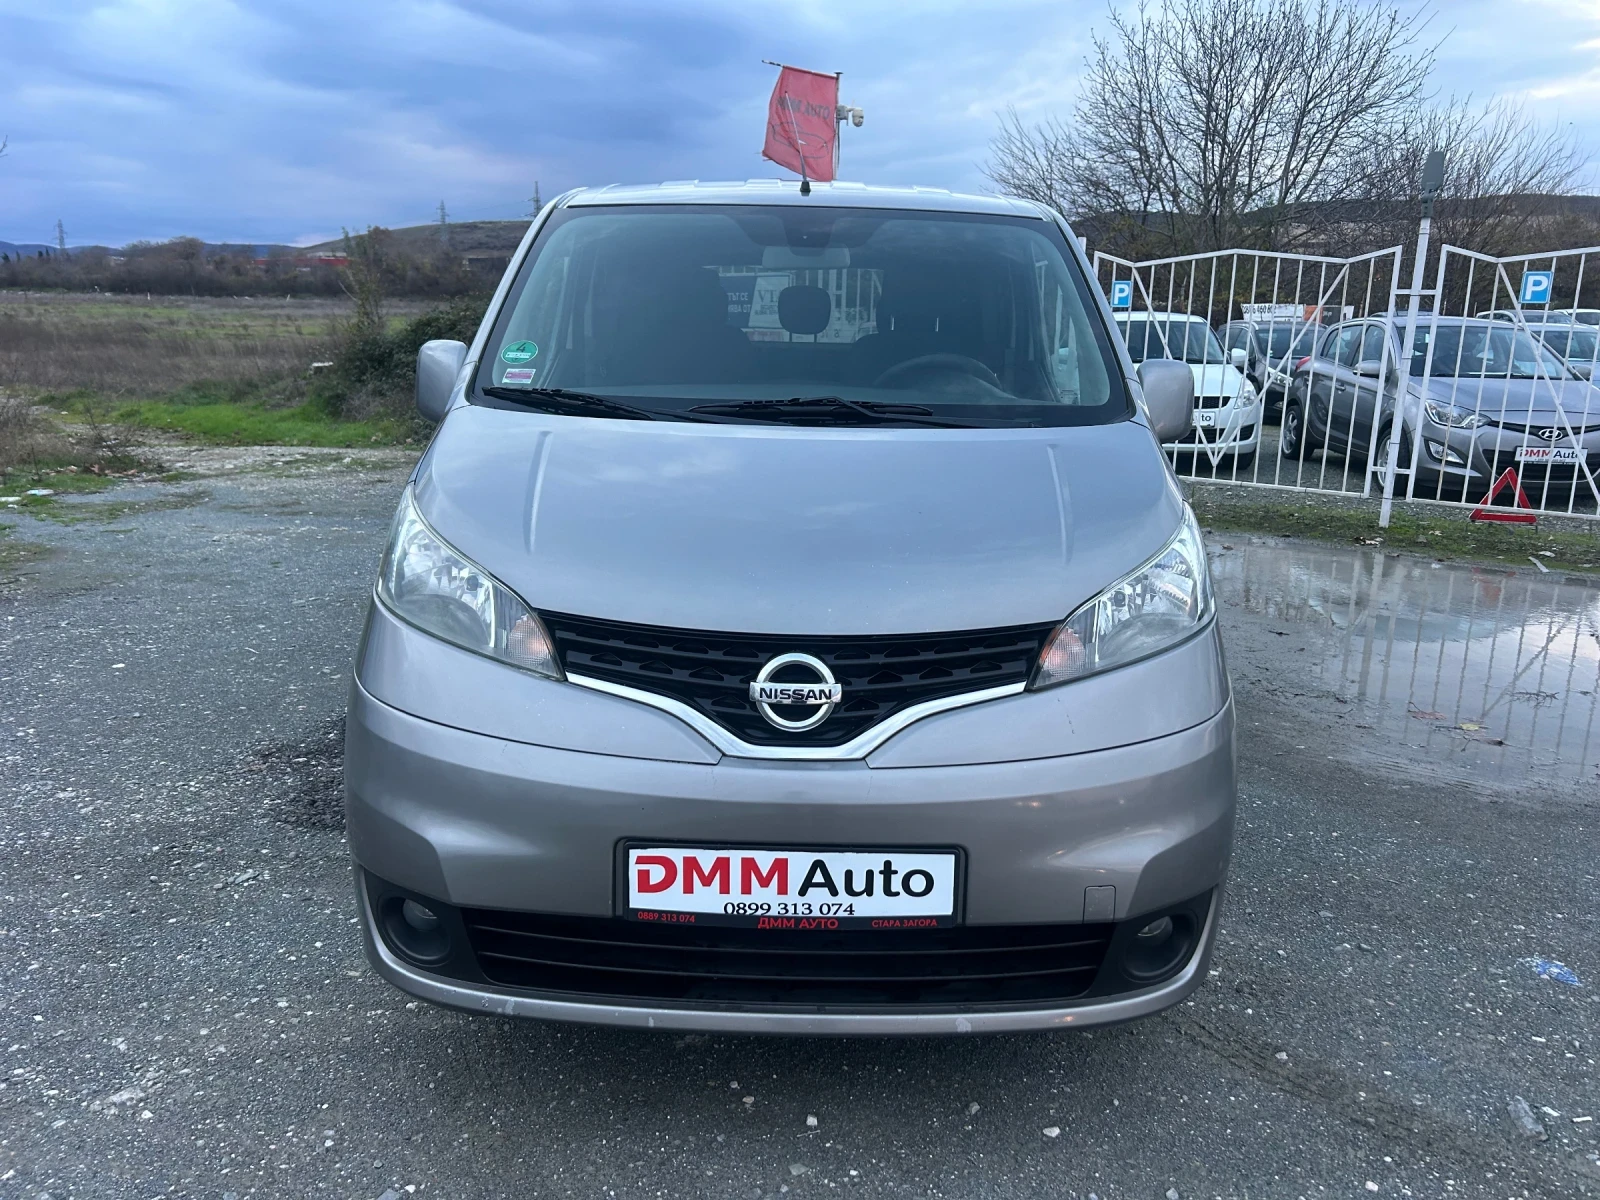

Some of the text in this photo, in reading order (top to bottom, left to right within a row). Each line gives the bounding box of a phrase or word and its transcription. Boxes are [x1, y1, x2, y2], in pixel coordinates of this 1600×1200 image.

[1114, 284, 1129, 304] P
[1525, 276, 1548, 300] P
[516, 342, 527, 353] 4
[760, 688, 831, 700] NISSAN
[635, 855, 935, 898] DMM Auto
[723, 902, 856, 916] 0899 313 074
[637, 911, 696, 923] 0889 313 074
[757, 917, 839, 929] ДММ АУТО
[871, 918, 937, 928] СТАРА ЗАГОРА
